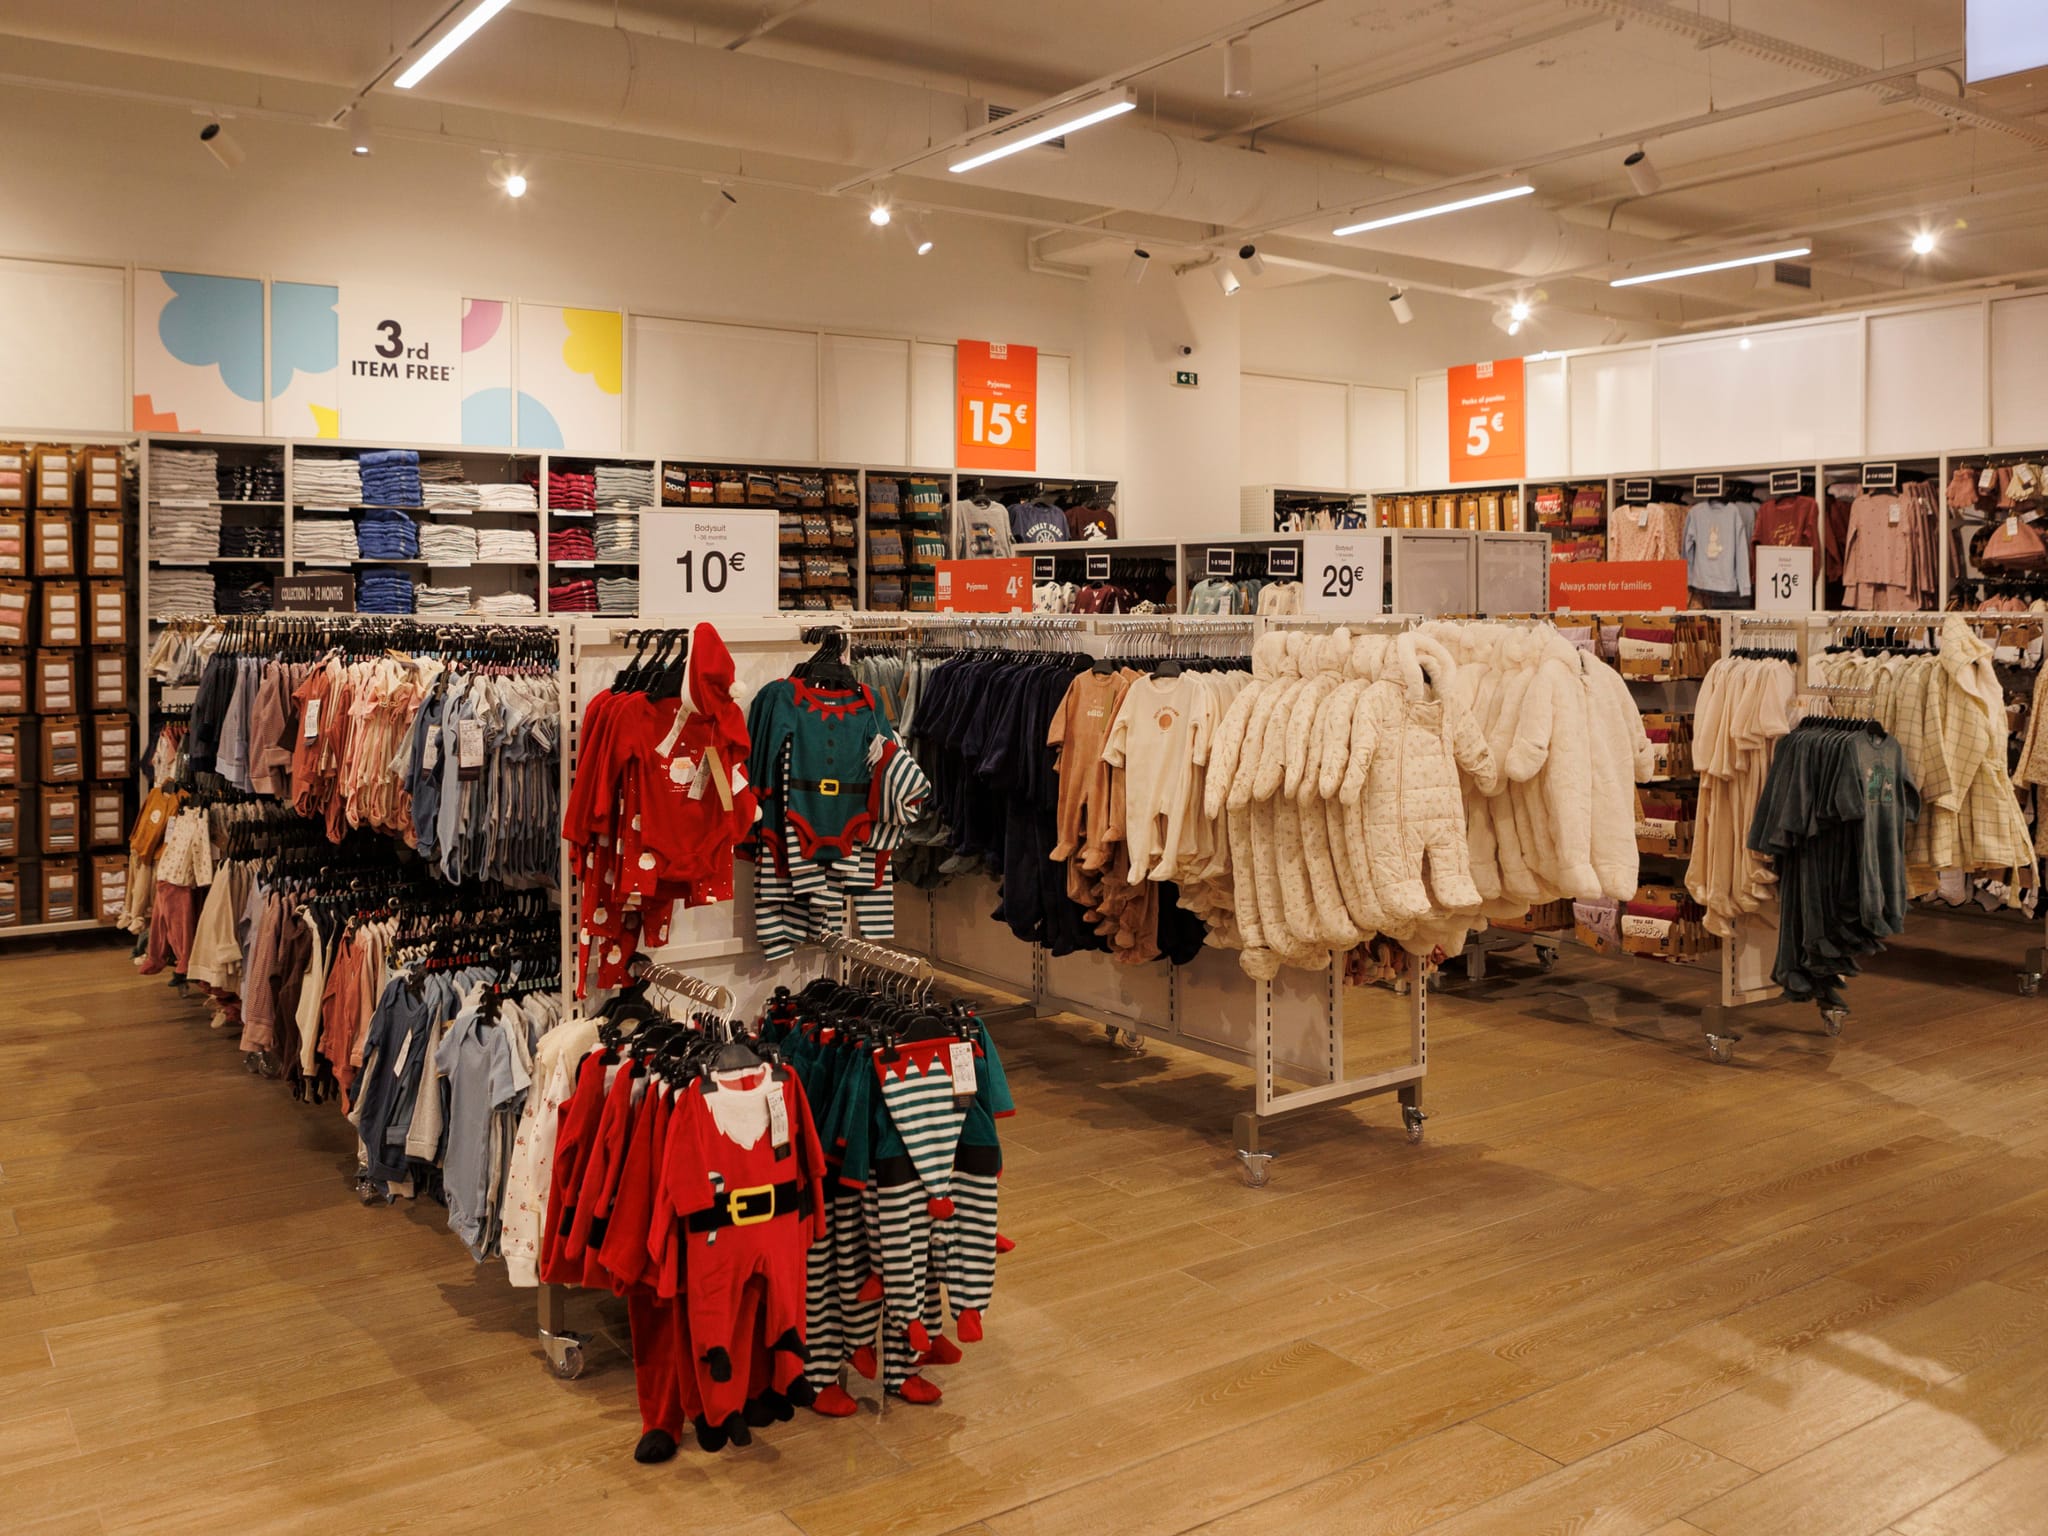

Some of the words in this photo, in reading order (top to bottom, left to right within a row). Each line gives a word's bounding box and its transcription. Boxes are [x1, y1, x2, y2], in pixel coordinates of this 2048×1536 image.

[374, 319, 430, 361] 3rd
[351, 360, 399, 379] ITEM
[969, 400, 1029, 446] 15€
[1466, 412, 1505, 457] 5€
[694, 523, 727, 534] Bodysuit
[676, 550, 746, 594] 10€
[1322, 564, 1365, 598] 29€
[281, 587, 307, 601] COLLECTION
[314, 586, 321, 601] 12
[321, 586, 344, 601] MONTHS
[966, 582, 989, 593] Pyjamas
[1005, 575, 1024, 599] 4€
[1559, 581, 1586, 592] Always
[1587, 583, 1607, 591] more
[1608, 581, 1619, 591] for
[1620, 580, 1653, 591] families
[1771, 572, 1800, 600] 13€
